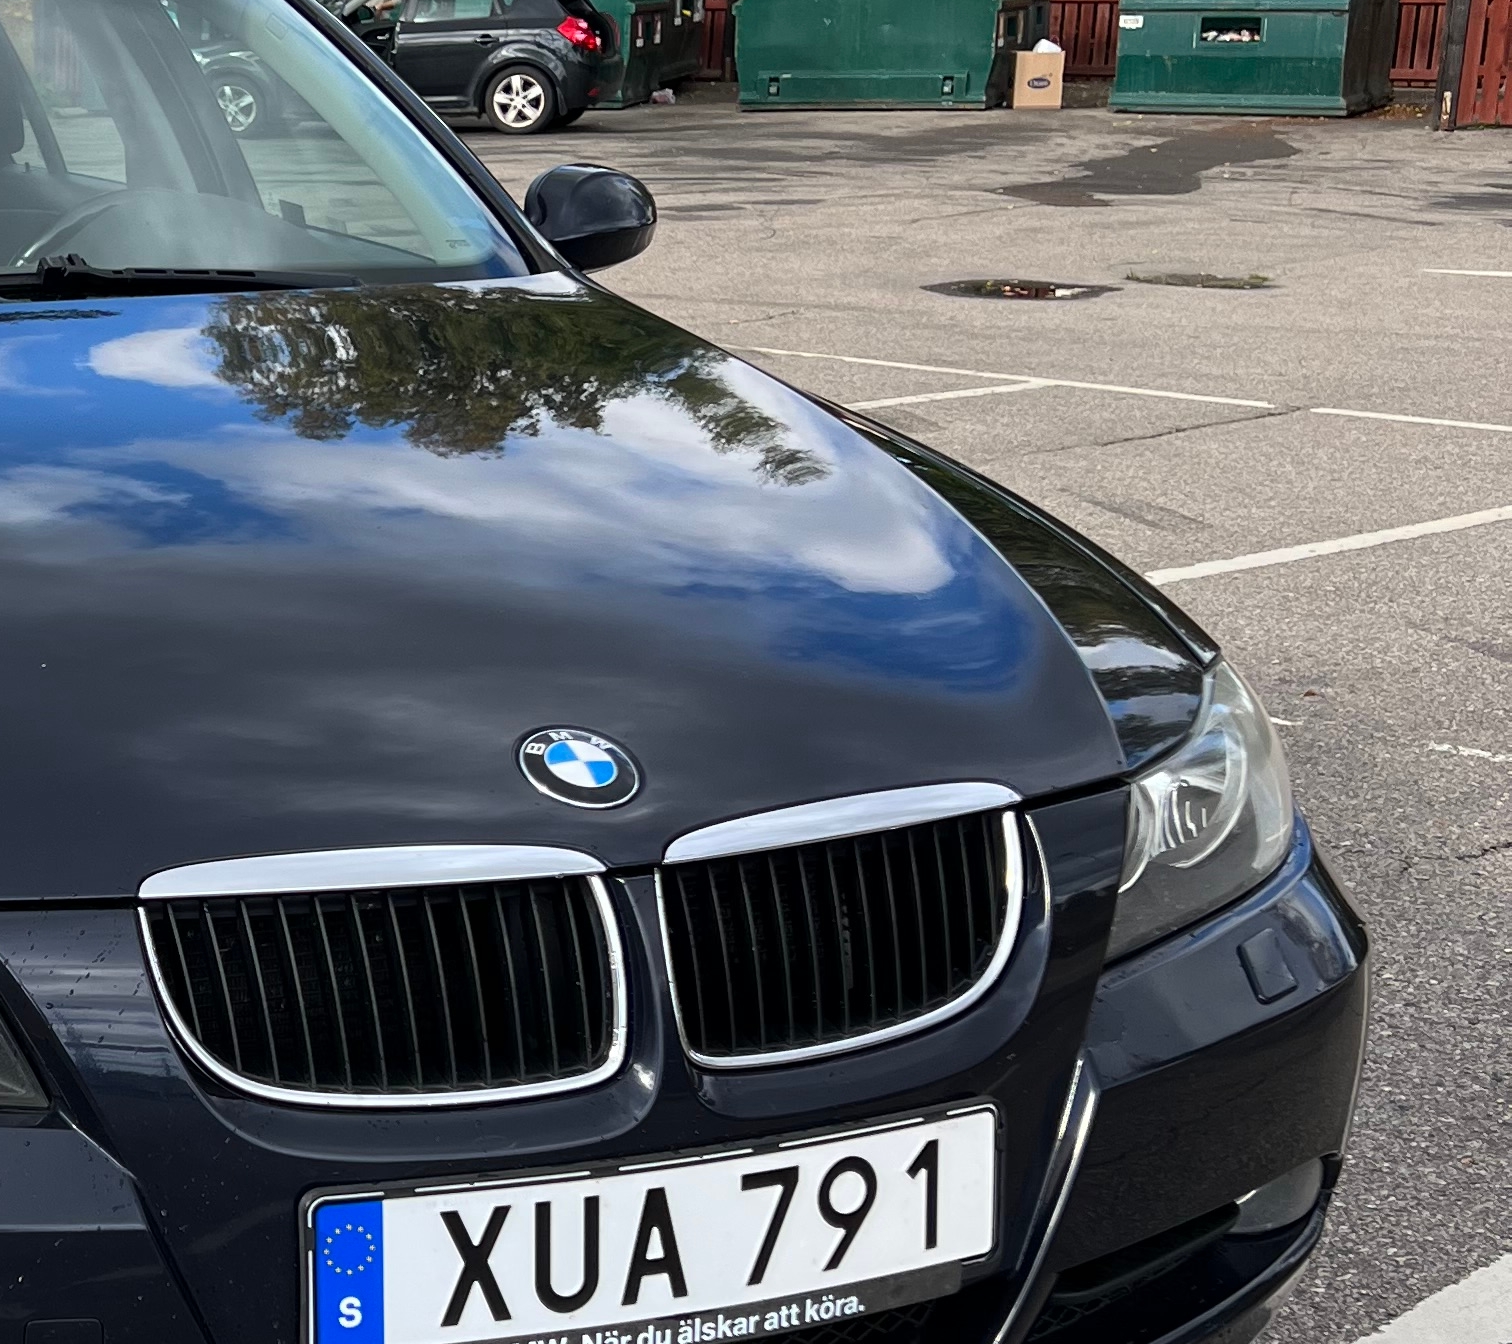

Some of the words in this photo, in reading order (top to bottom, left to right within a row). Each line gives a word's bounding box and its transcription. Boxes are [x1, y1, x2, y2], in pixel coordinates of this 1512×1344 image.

[525, 731, 613, 756] BMW
[439, 1186, 689, 1328] XUA
[740, 1138, 940, 1287] 791
[338, 1296, 363, 1329] S
[763, 1303, 801, 1332] att
[804, 1294, 866, 1324] köra.
